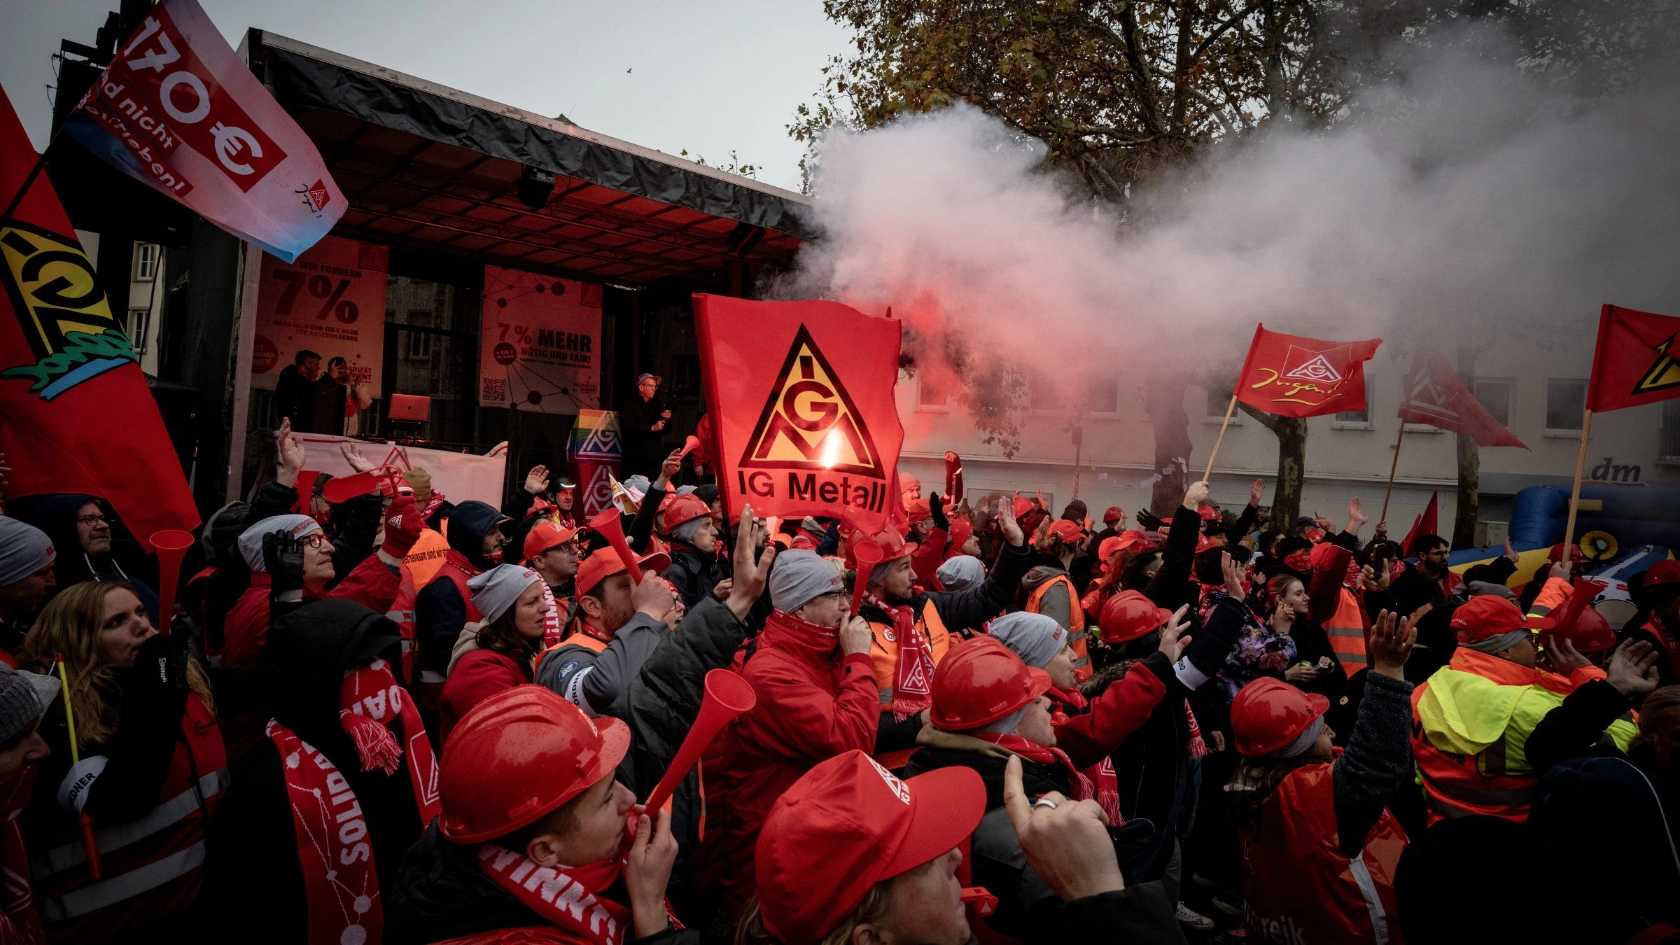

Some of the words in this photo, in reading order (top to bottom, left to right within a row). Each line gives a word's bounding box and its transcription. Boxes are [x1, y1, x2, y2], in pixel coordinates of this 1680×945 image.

[124, 15, 210, 124] 170
[210, 121, 263, 175] €
[118, 97, 173, 149] nicht
[300, 261, 318, 271] WIR
[320, 264, 362, 279] FORDERN
[273, 269, 359, 324] 7%
[310, 323, 323, 331] UND
[538, 329, 592, 353] MEHR
[521, 346, 548, 359] NÖTIG
[549, 350, 568, 361] UND
[570, 353, 591, 363] FAIR!
[1591, 457, 1641, 482] dm
[738, 470, 774, 498] IG
[788, 472, 887, 513] Metall
